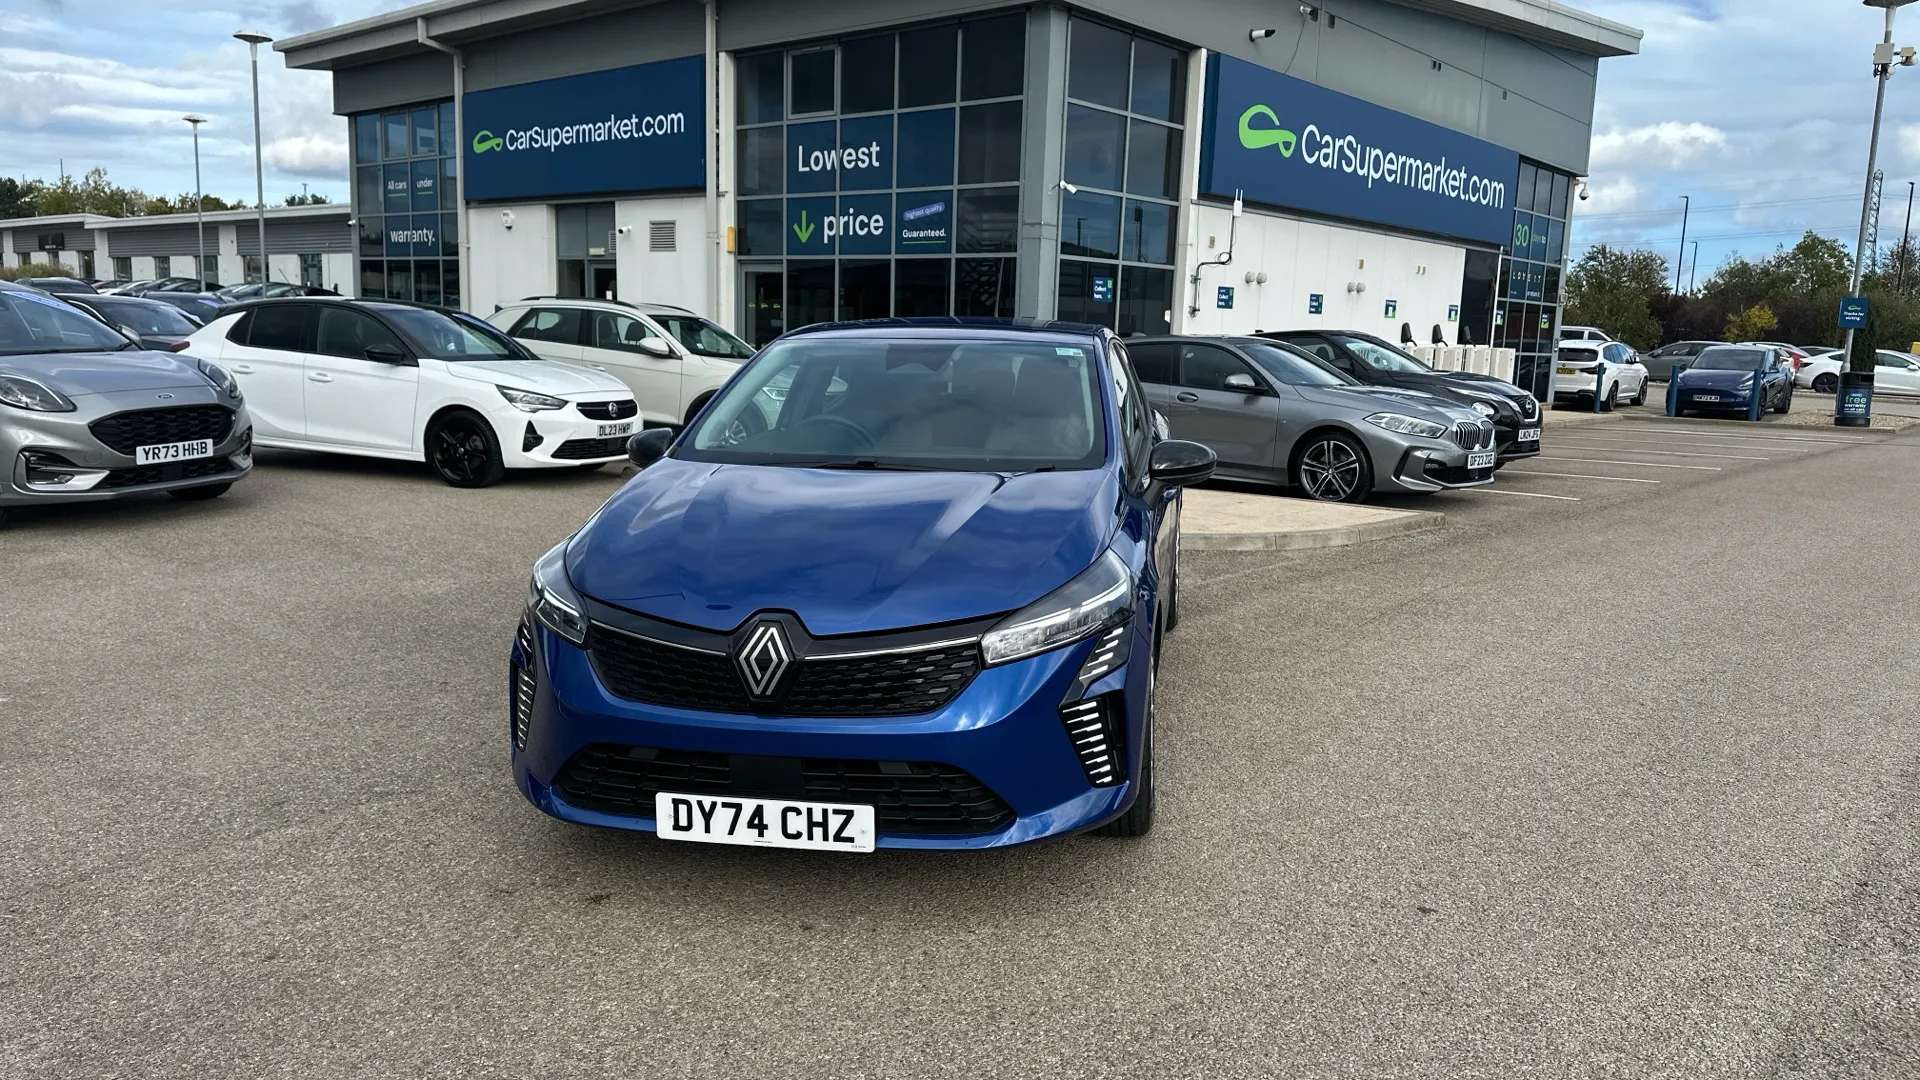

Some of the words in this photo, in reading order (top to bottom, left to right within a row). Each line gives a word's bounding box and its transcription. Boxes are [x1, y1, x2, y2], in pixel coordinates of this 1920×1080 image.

[505, 111, 685, 152] CarSupermarket.com
[798, 141, 880, 172] Lowest
[1301, 124, 1505, 209] CarSupermarket.com
[387, 180, 395, 190] All
[395, 182, 407, 190] cars
[416, 177, 433, 188] under
[823, 207, 884, 243] price
[902, 227, 946, 238] Guaranteed.
[390, 227, 435, 246] warranty.
[1515, 224, 1529, 247] 30
[1845, 395, 1867, 404] free
[143, 444, 179, 460] YR73
[183, 441, 208, 457] HHB
[1470, 454, 1484, 466] DF23
[671, 798, 768, 837] DY74
[781, 806, 855, 843] CHZ
